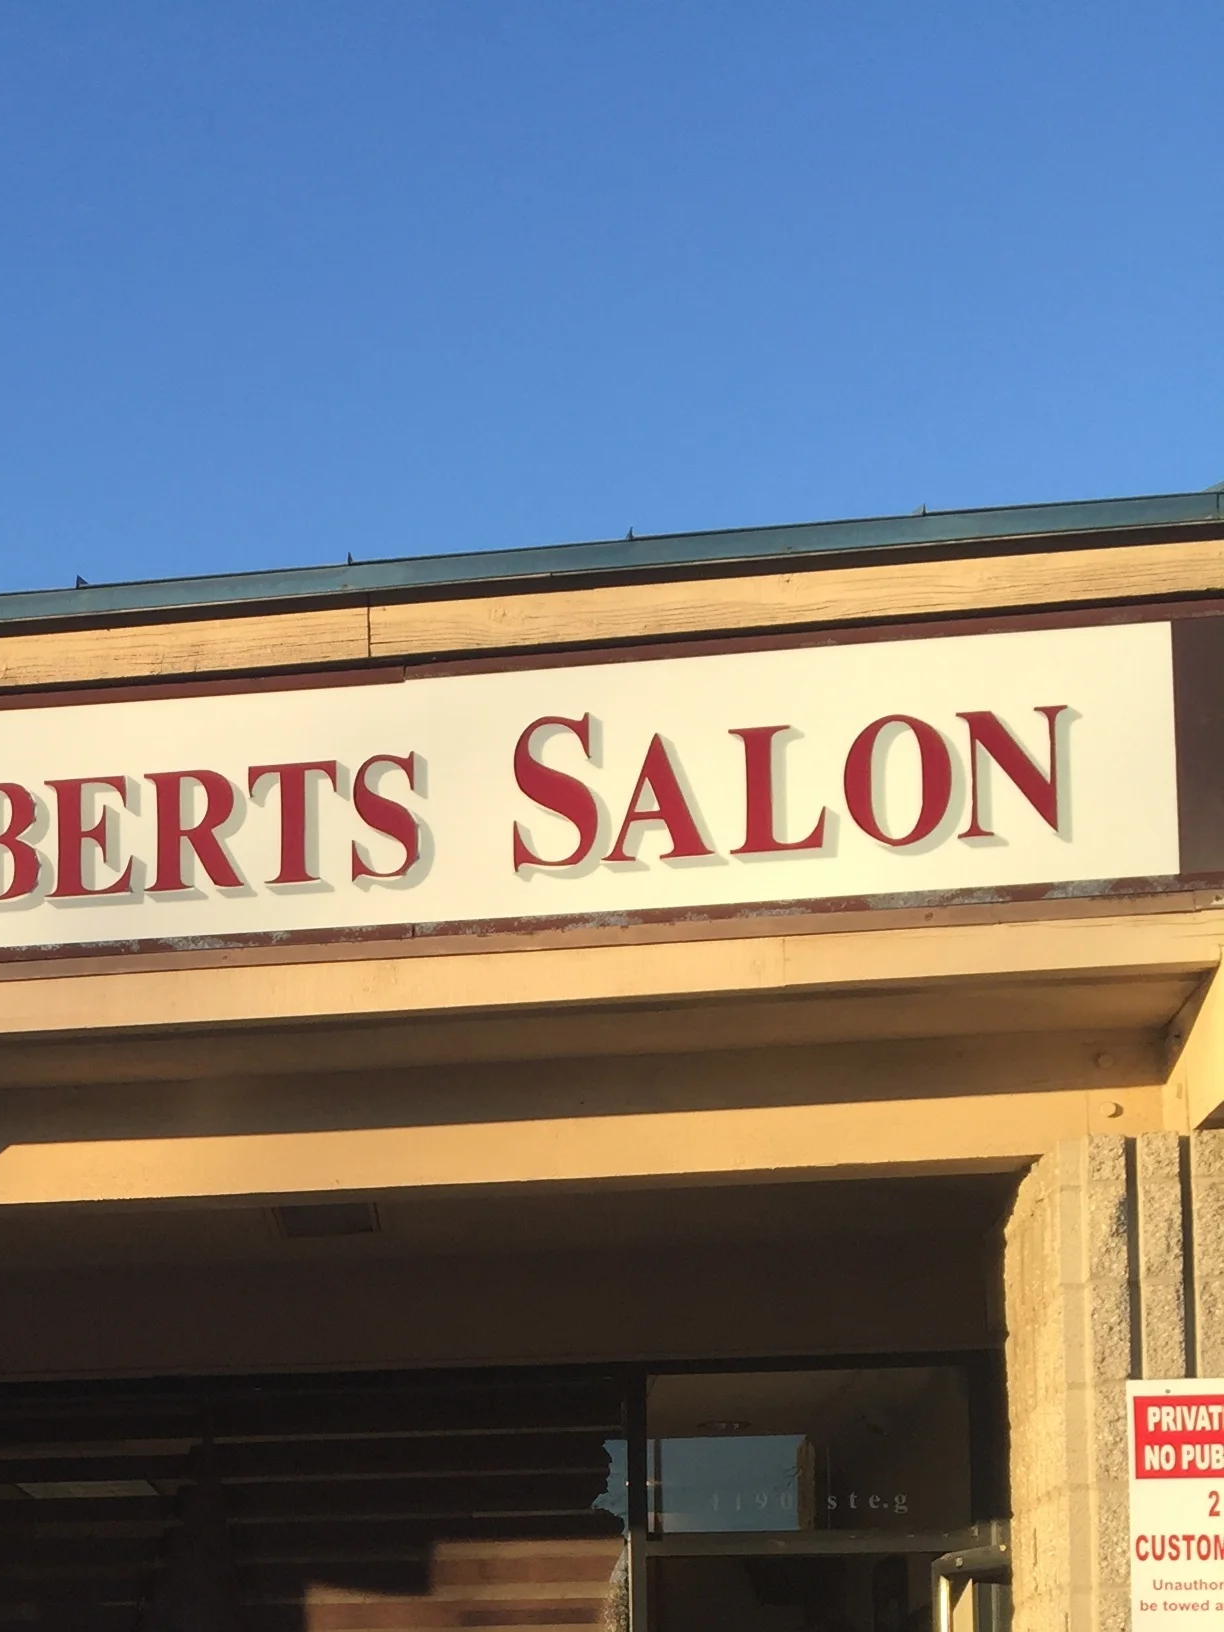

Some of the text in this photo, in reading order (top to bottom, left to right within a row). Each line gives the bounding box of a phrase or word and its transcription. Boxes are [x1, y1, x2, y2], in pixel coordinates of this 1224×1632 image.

[513, 704, 1069, 873] SALON
[1147, 1405, 1224, 1433] PRIVAT
[1144, 1444, 1176, 1471] NO
[1208, 1489, 1221, 1517] 2
[1140, 1600, 1158, 1611] be
[1163, 1600, 1210, 1611] towed
